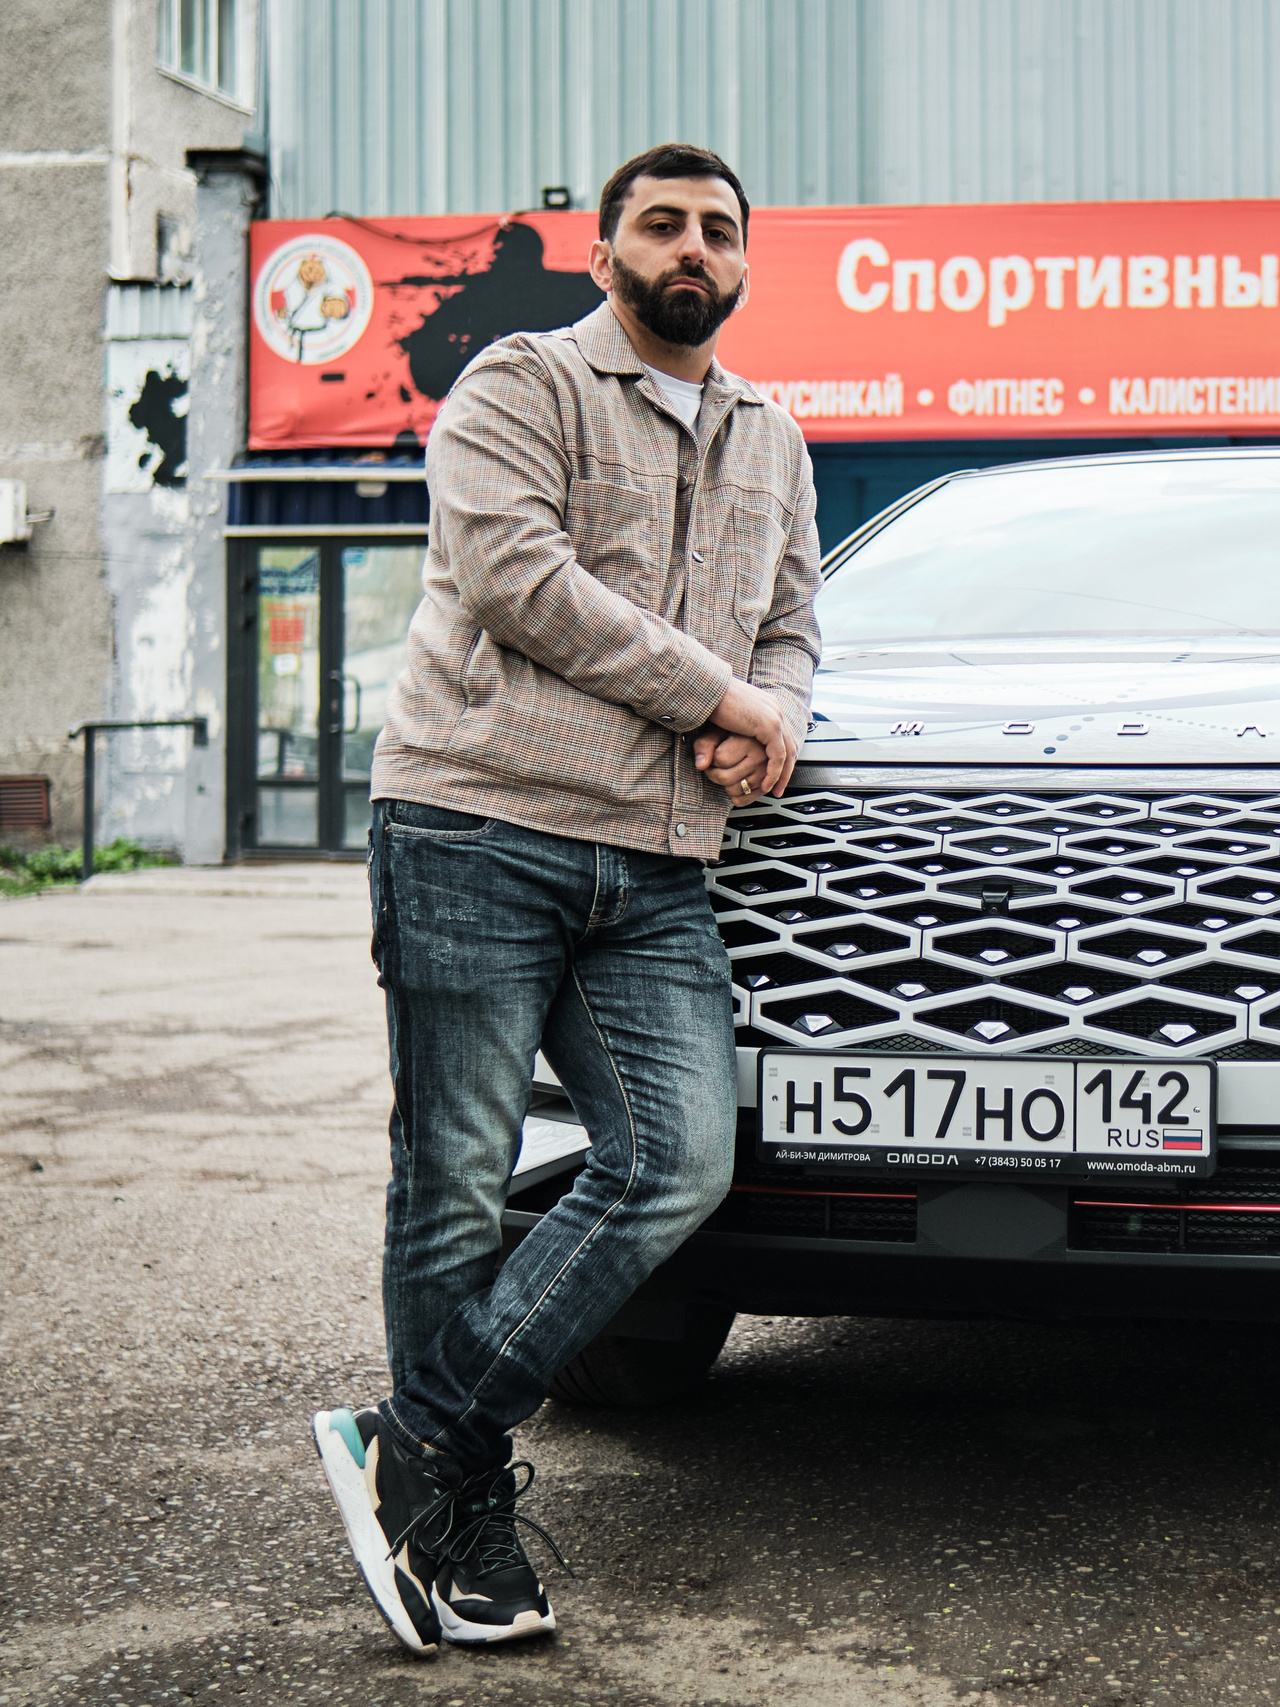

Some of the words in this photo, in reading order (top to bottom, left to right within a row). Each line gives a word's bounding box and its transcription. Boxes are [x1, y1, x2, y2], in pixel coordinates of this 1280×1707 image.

[946, 377, 1065, 418] ФИТНЕС
[785, 1066, 1066, 1143] Н517НО
[1083, 1069, 1190, 1125] 142
[1106, 1128, 1160, 1149] RUS
[775, 1150, 817, 1161] АЙ-БИ-ЭМ
[817, 1152, 871, 1163] ДИМИТРОВА
[886, 1152, 960, 1166] OMODA
[974, 1156, 987, 1166] +7
[988, 1156, 1019, 1168] (3843)
[1021, 1157, 1033, 1168] 50
[1034, 1158, 1047, 1168] 05
[1049, 1158, 1061, 1169] 17
[1087, 1160, 1196, 1174] www.omoda-abm.ru
